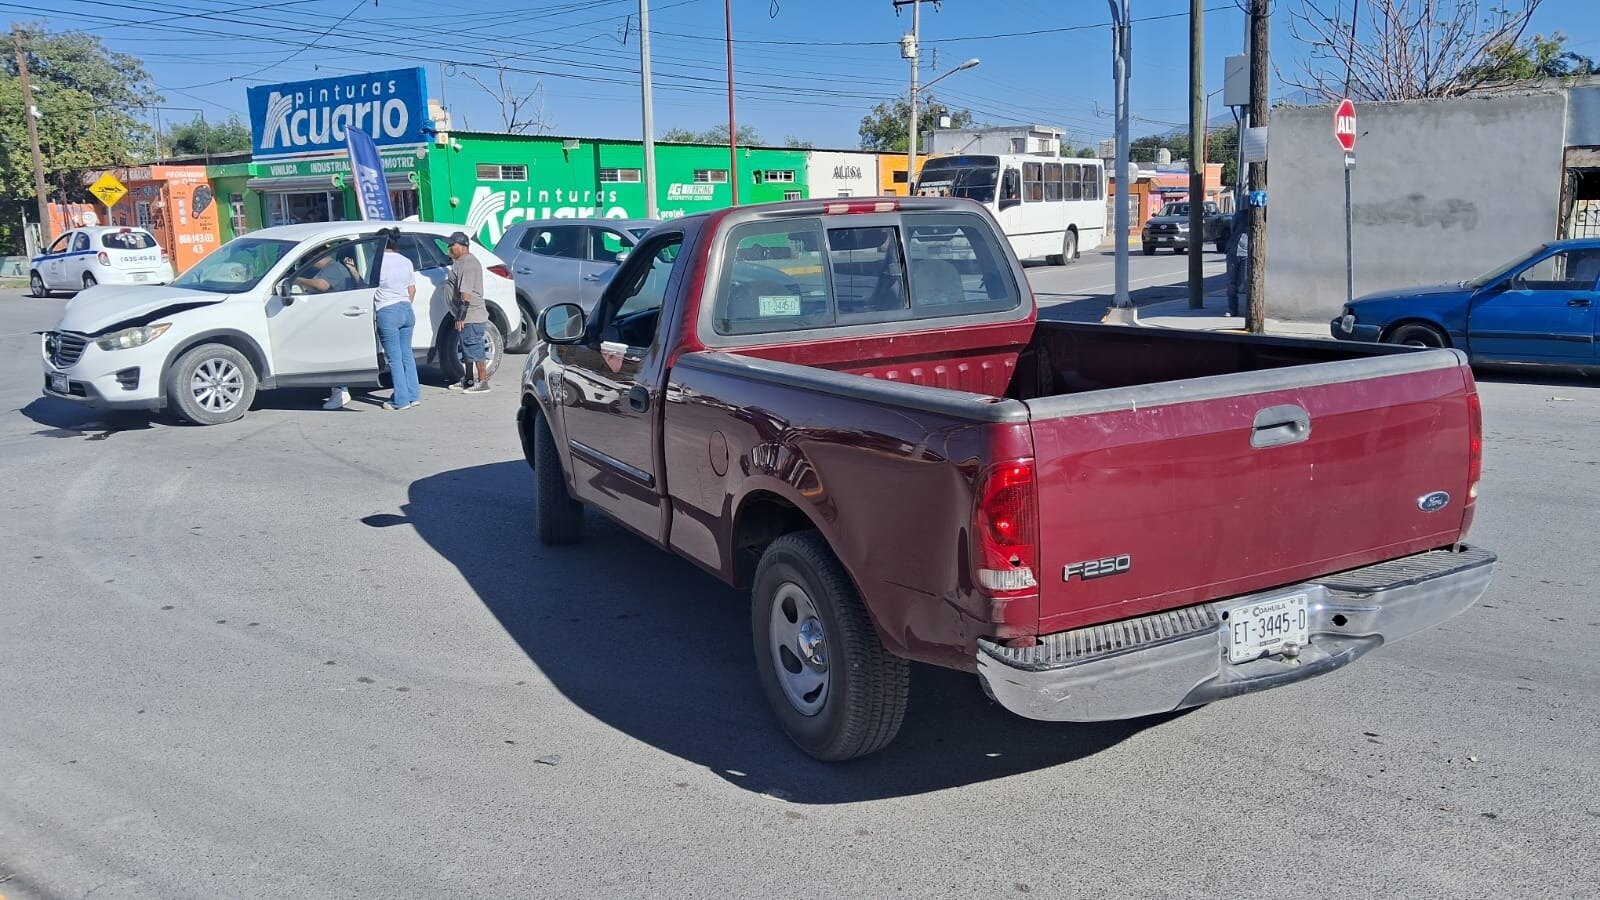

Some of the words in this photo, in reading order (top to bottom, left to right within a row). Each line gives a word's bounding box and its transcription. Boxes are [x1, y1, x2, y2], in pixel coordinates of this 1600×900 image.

[295, 79, 396, 109] pinturas
[260, 91, 409, 149] Acuario
[310, 160, 351, 173] INDUSTRIAL
[510, 186, 616, 206] pinturas
[1234, 608, 1306, 645] ET-3445-D
